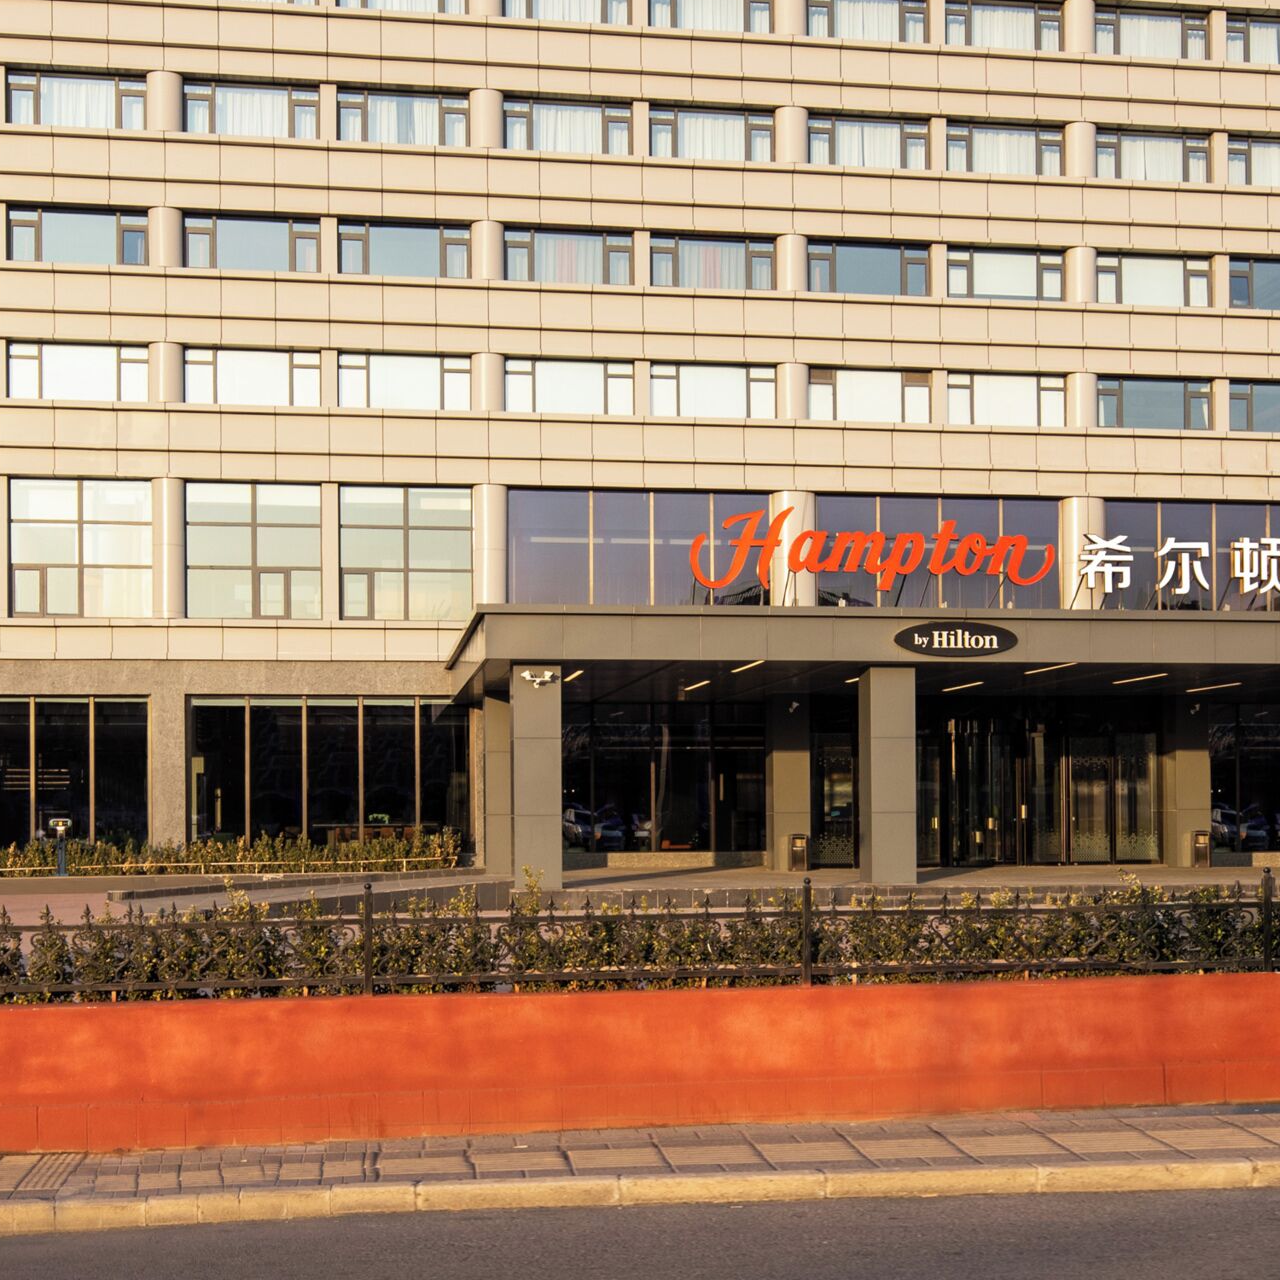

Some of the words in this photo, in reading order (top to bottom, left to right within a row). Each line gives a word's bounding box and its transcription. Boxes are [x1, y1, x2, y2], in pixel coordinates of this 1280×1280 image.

[689, 506, 1056, 591] Hampton
[914, 633, 929, 648] by
[932, 630, 999, 649] Hilton
